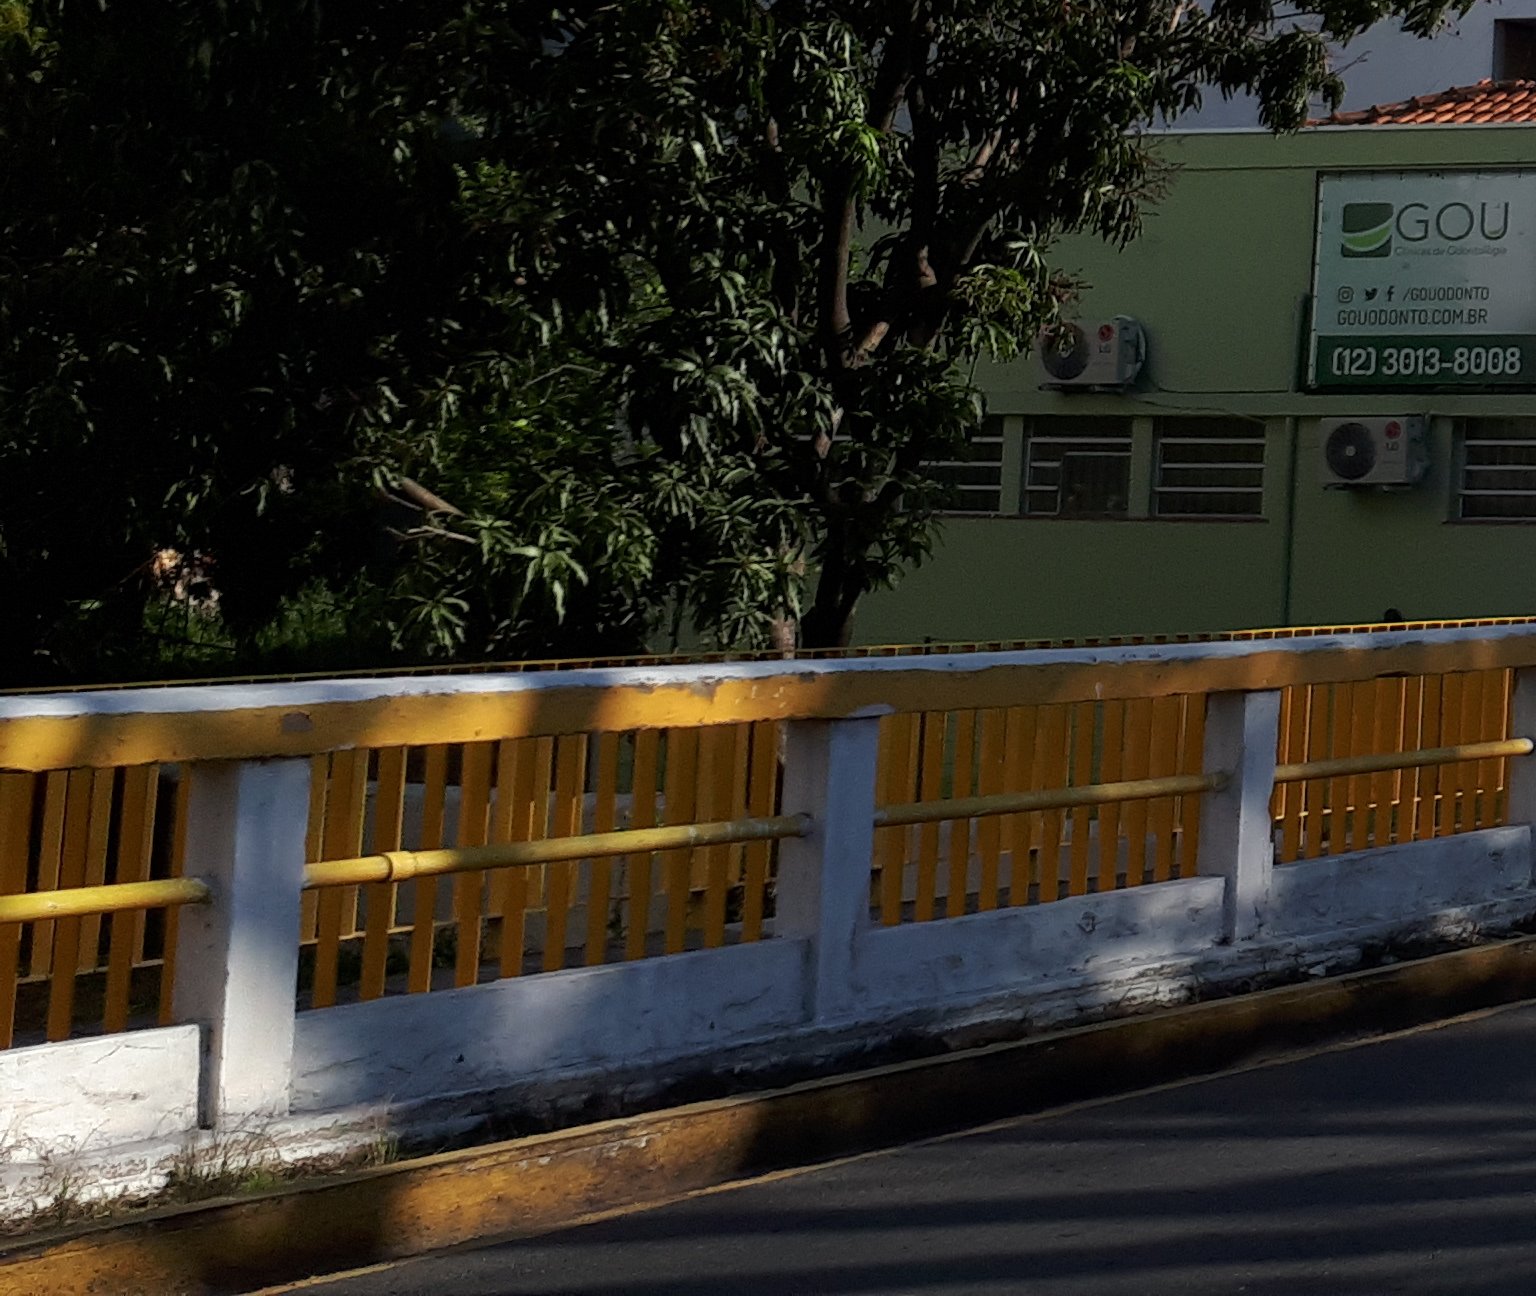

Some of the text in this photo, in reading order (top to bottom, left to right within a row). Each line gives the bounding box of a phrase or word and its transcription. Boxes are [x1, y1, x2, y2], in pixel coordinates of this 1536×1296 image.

[1396, 202, 1510, 242] GOU
[1337, 308, 1488, 325] GOUODONTO.COM.BR
[1332, 346, 1521, 376] (12) 3013-8008
